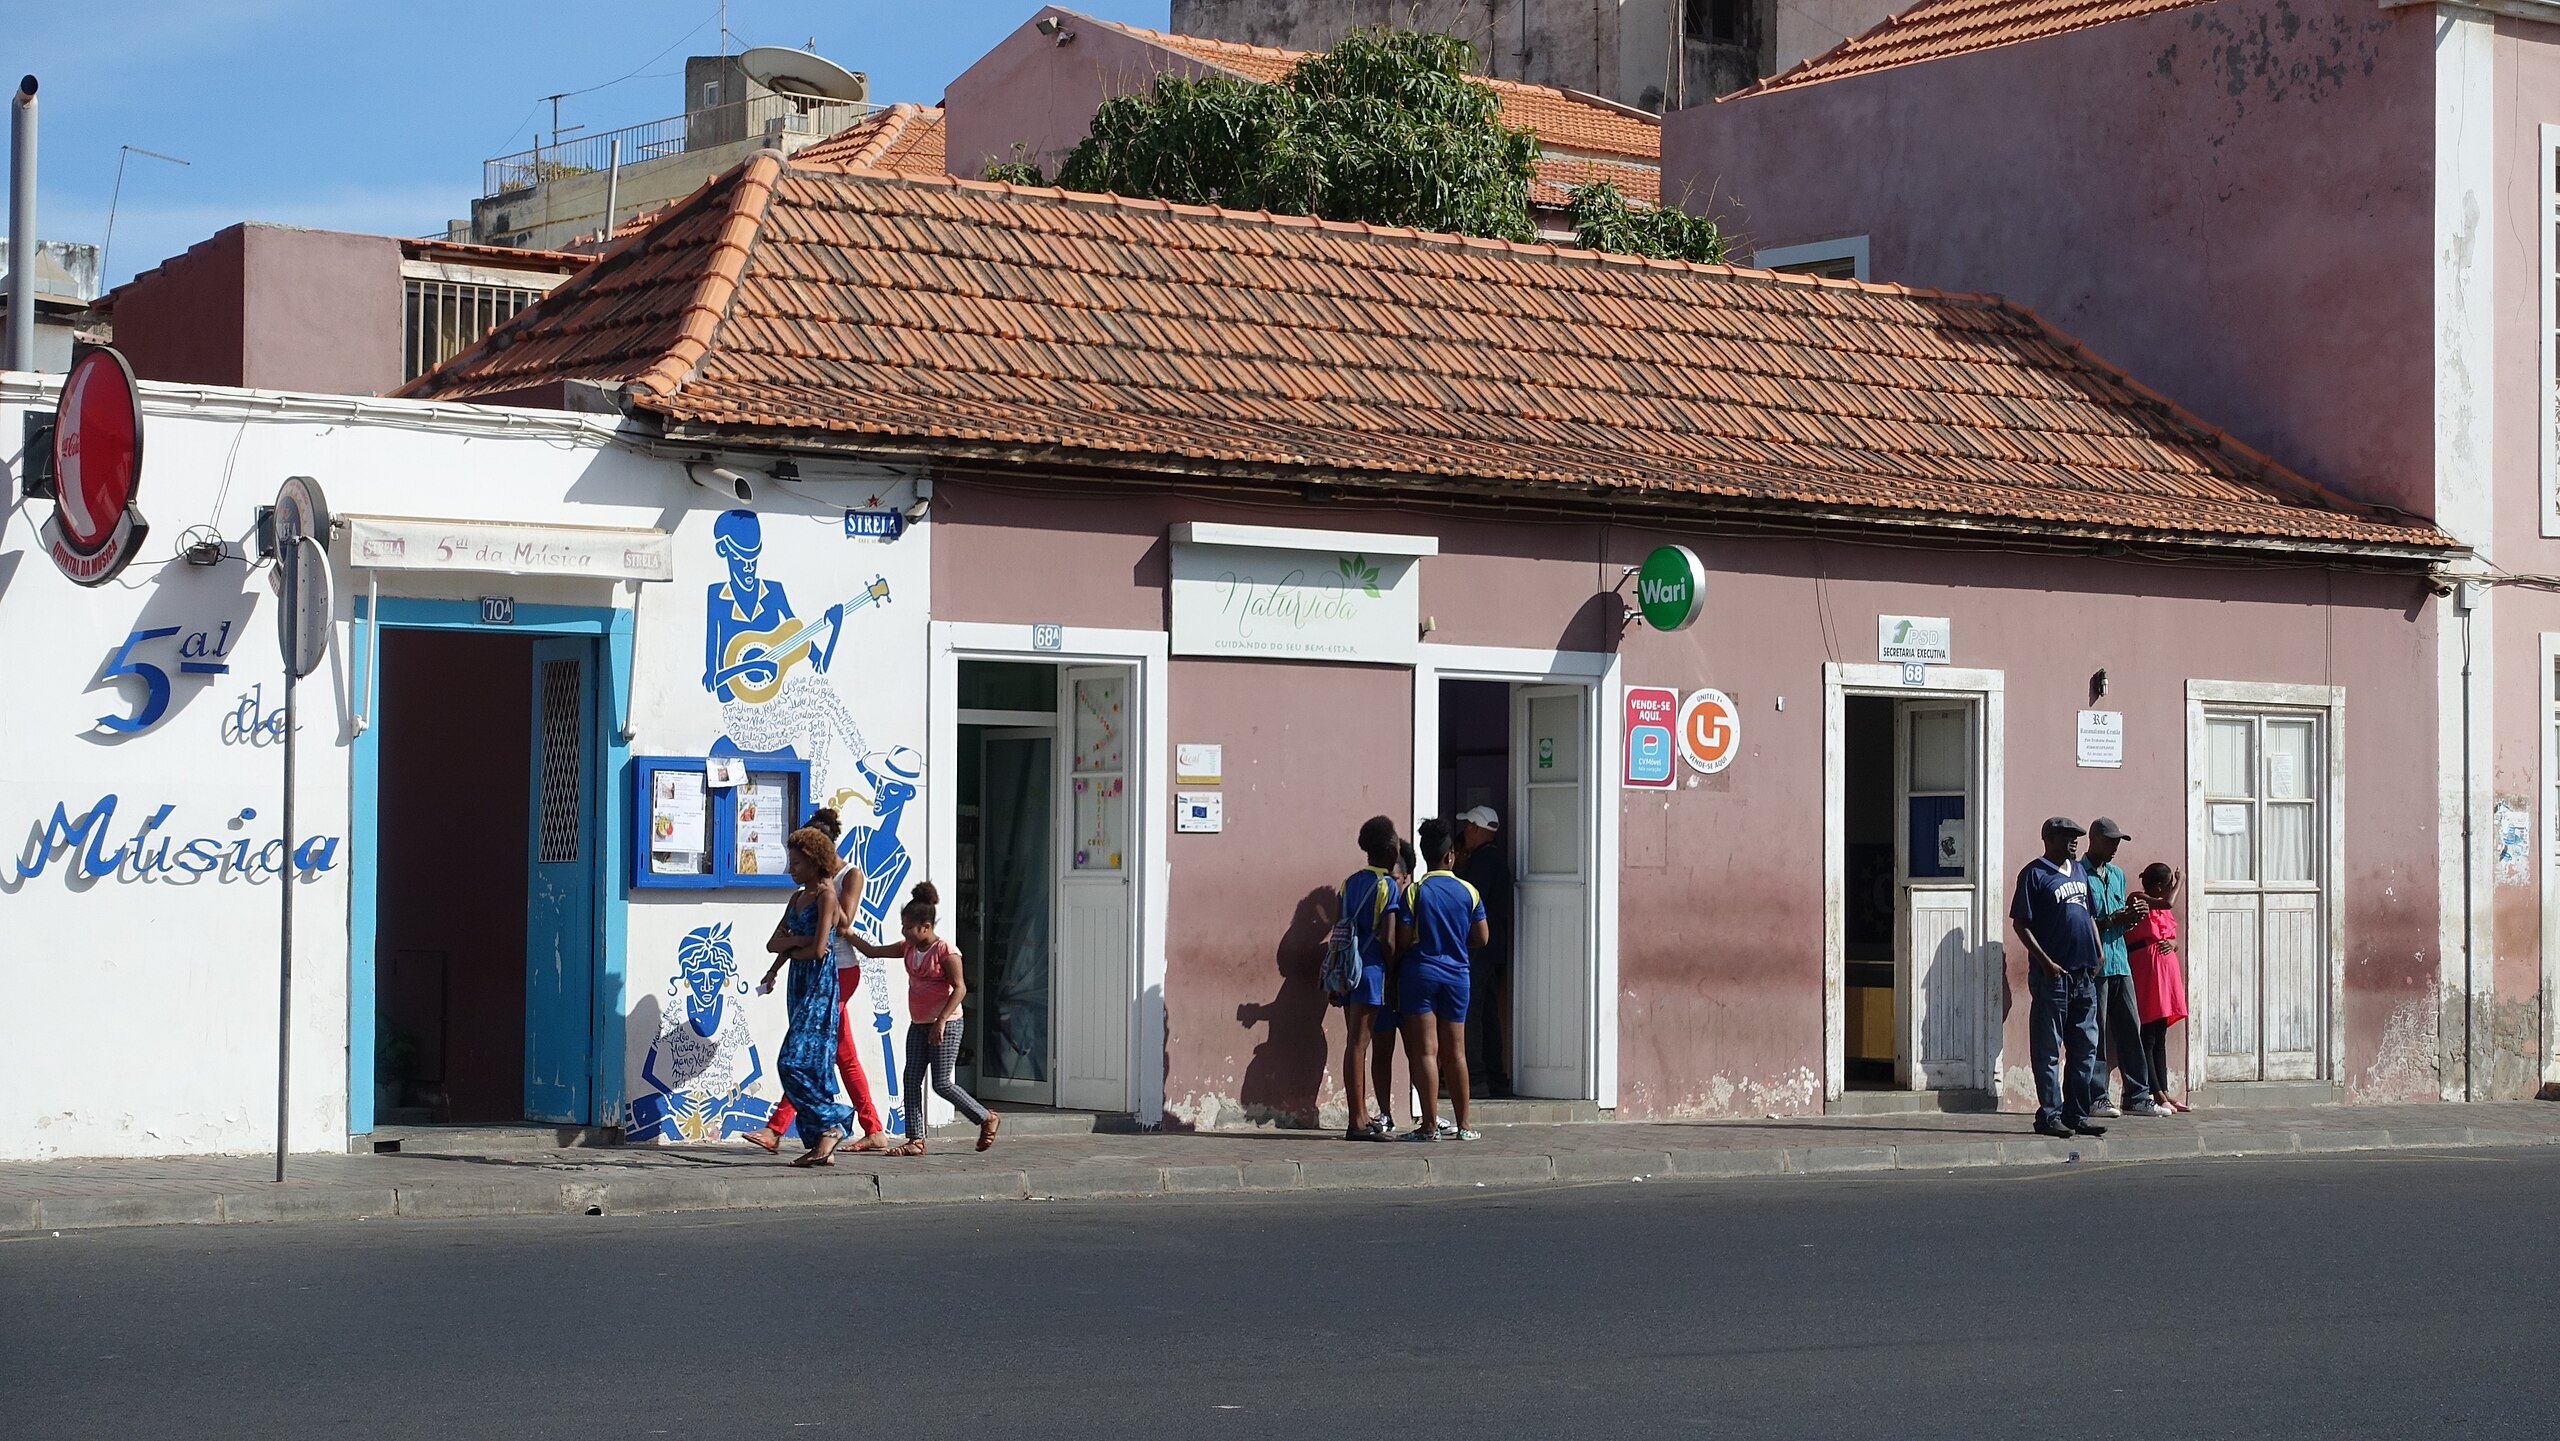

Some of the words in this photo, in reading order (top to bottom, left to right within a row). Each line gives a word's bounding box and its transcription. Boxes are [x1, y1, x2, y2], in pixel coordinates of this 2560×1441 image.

[848, 513, 898, 534] STRELA
[365, 540, 404, 556] STRELA
[475, 544, 504, 562] da
[507, 541, 592, 568] Música
[53, 540, 80, 575] QUINTAL
[80, 559, 90, 576] DA
[91, 538, 118, 575] MÚSICA
[625, 551, 660, 569] STRELA
[1640, 577, 1686, 604] Wari
[485, 600, 511, 620] 70A
[1215, 569, 1358, 638] Naturvida
[1036, 628, 1059, 647] 68A
[1908, 629, 1939, 646] PSD
[1215, 640, 1267, 650] CUIDANDO
[1270, 642, 1283, 650] DO
[1286, 642, 1301, 652] SEU
[1305, 643, 1358, 654] BEM-ESTAR
[1883, 647, 1915, 658] SECRETARIA
[1917, 648, 1946, 659] EXECUTIVA
[1905, 665, 1923, 682] 68
[1631, 699, 1671, 711] VENDE-SE
[1696, 693, 1715, 703] UNITEL
[1638, 710, 1662, 721] AQUI.
[2093, 713, 2108, 726] RC
[1688, 753, 1713, 770] VENDE-SE
[1714, 756, 1728, 769] AQUI
[16, 793, 341, 878] Música
